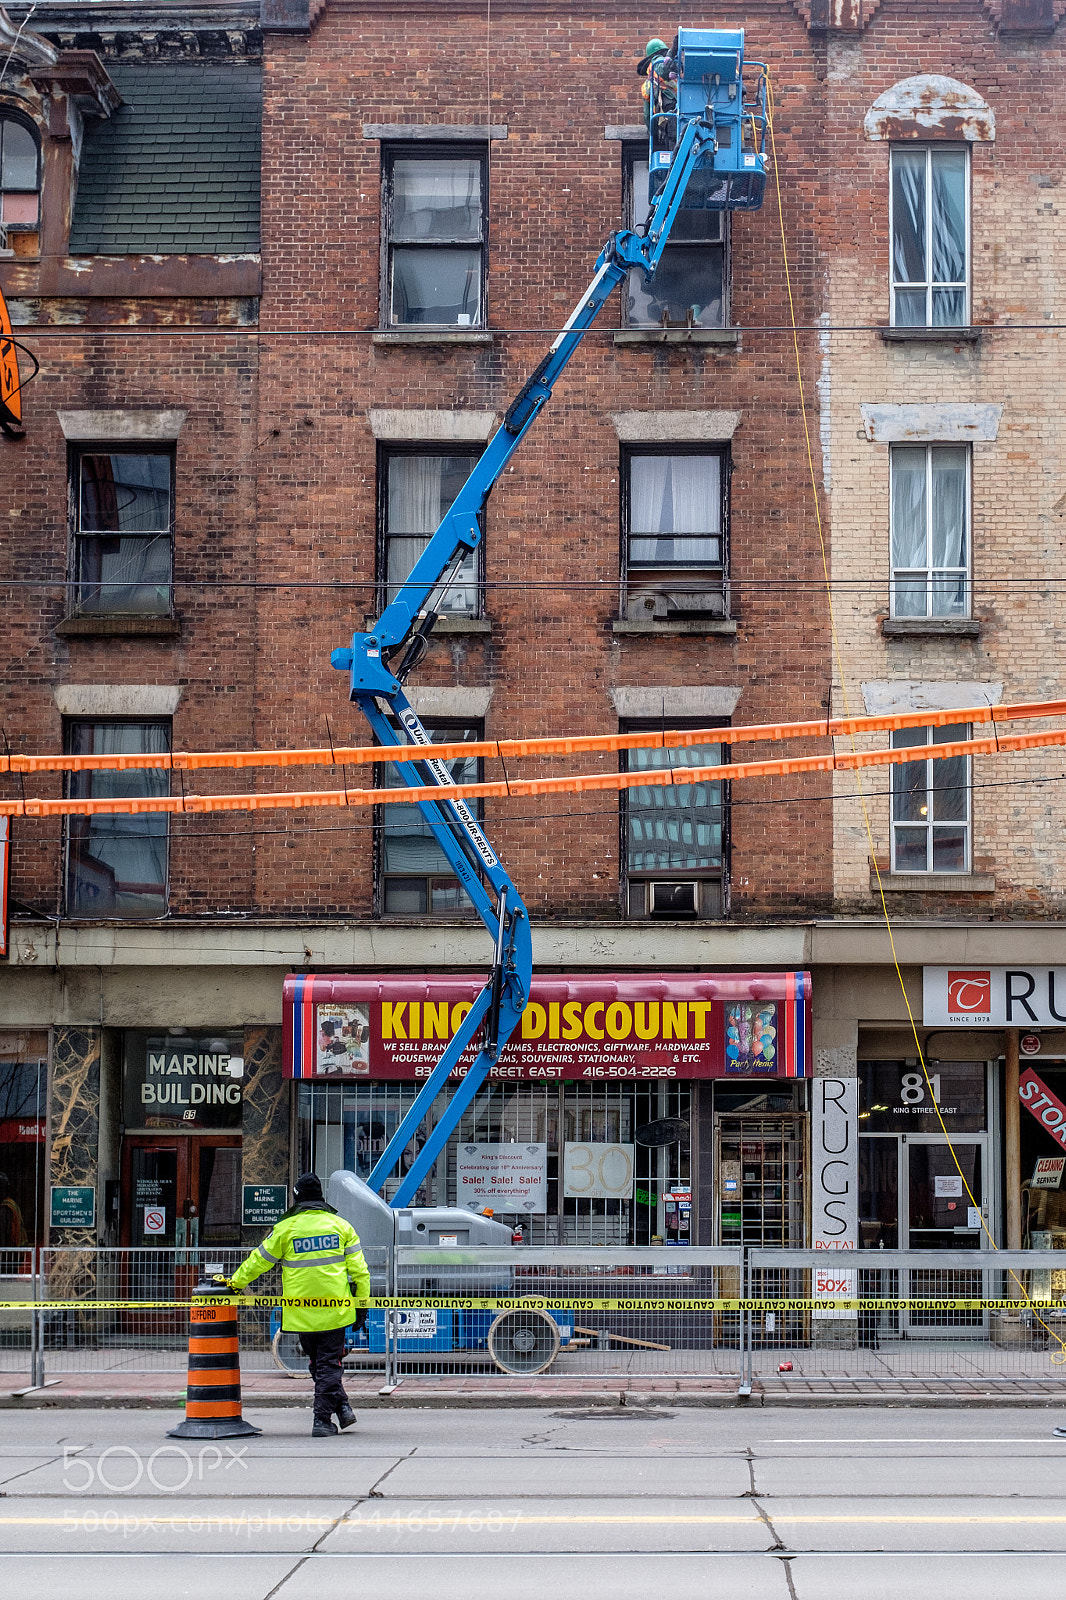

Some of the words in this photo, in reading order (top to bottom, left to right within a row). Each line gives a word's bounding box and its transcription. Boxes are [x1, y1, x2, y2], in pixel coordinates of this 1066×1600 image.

[521, 1001, 711, 1040] DISCOUNT
[383, 1043, 397, 1051] WE
[398, 1043, 420, 1051] SELL
[537, 1043, 601, 1053] ELECTRONICS,
[603, 1043, 652, 1052] GIFTWARE,
[655, 1043, 710, 1051] HARDWARES
[521, 1054, 575, 1064] SOUVENIRS,
[577, 1054, 636, 1064] STATIONARY,
[673, 1055, 680, 1063] &
[682, 1054, 701, 1063] ETC.
[149, 1054, 231, 1076] MARINE
[528, 1066, 564, 1077] EAST
[582, 1066, 677, 1077] 416-504-2226
[901, 1073, 941, 1104] 81
[141, 1083, 241, 1105] BUILDING
[184, 1110, 196, 1119] 85
[1038, 1159, 1064, 1173] CLEANING
[462, 1176, 485, 1184] Sale!
[490, 1176, 513, 1184] Sale!
[519, 1176, 542, 1184] Sale!
[1036, 1176, 1059, 1185] SERVICE
[294, 1235, 339, 1253] POLICE
[817, 1279, 848, 1292] 50%
[254, 1299, 301, 1307] CAUTION
[303, 1299, 351, 1307] CAUTION
[375, 1299, 422, 1308] CAUTION
[425, 1299, 472, 1308] CAUTION
[496, 1300, 543, 1309] CAUTION
[546, 1300, 594, 1309] CAUTION
[617, 1301, 664, 1309] CAUTION
[667, 1301, 714, 1309] CAUTION
[738, 1301, 786, 1309] CAUTION
[788, 1301, 835, 1309] CAUTION
[859, 1301, 906, 1310] CAUTION
[909, 1300, 956, 1309] CAUTION
[980, 1300, 1027, 1308] CAUTION
